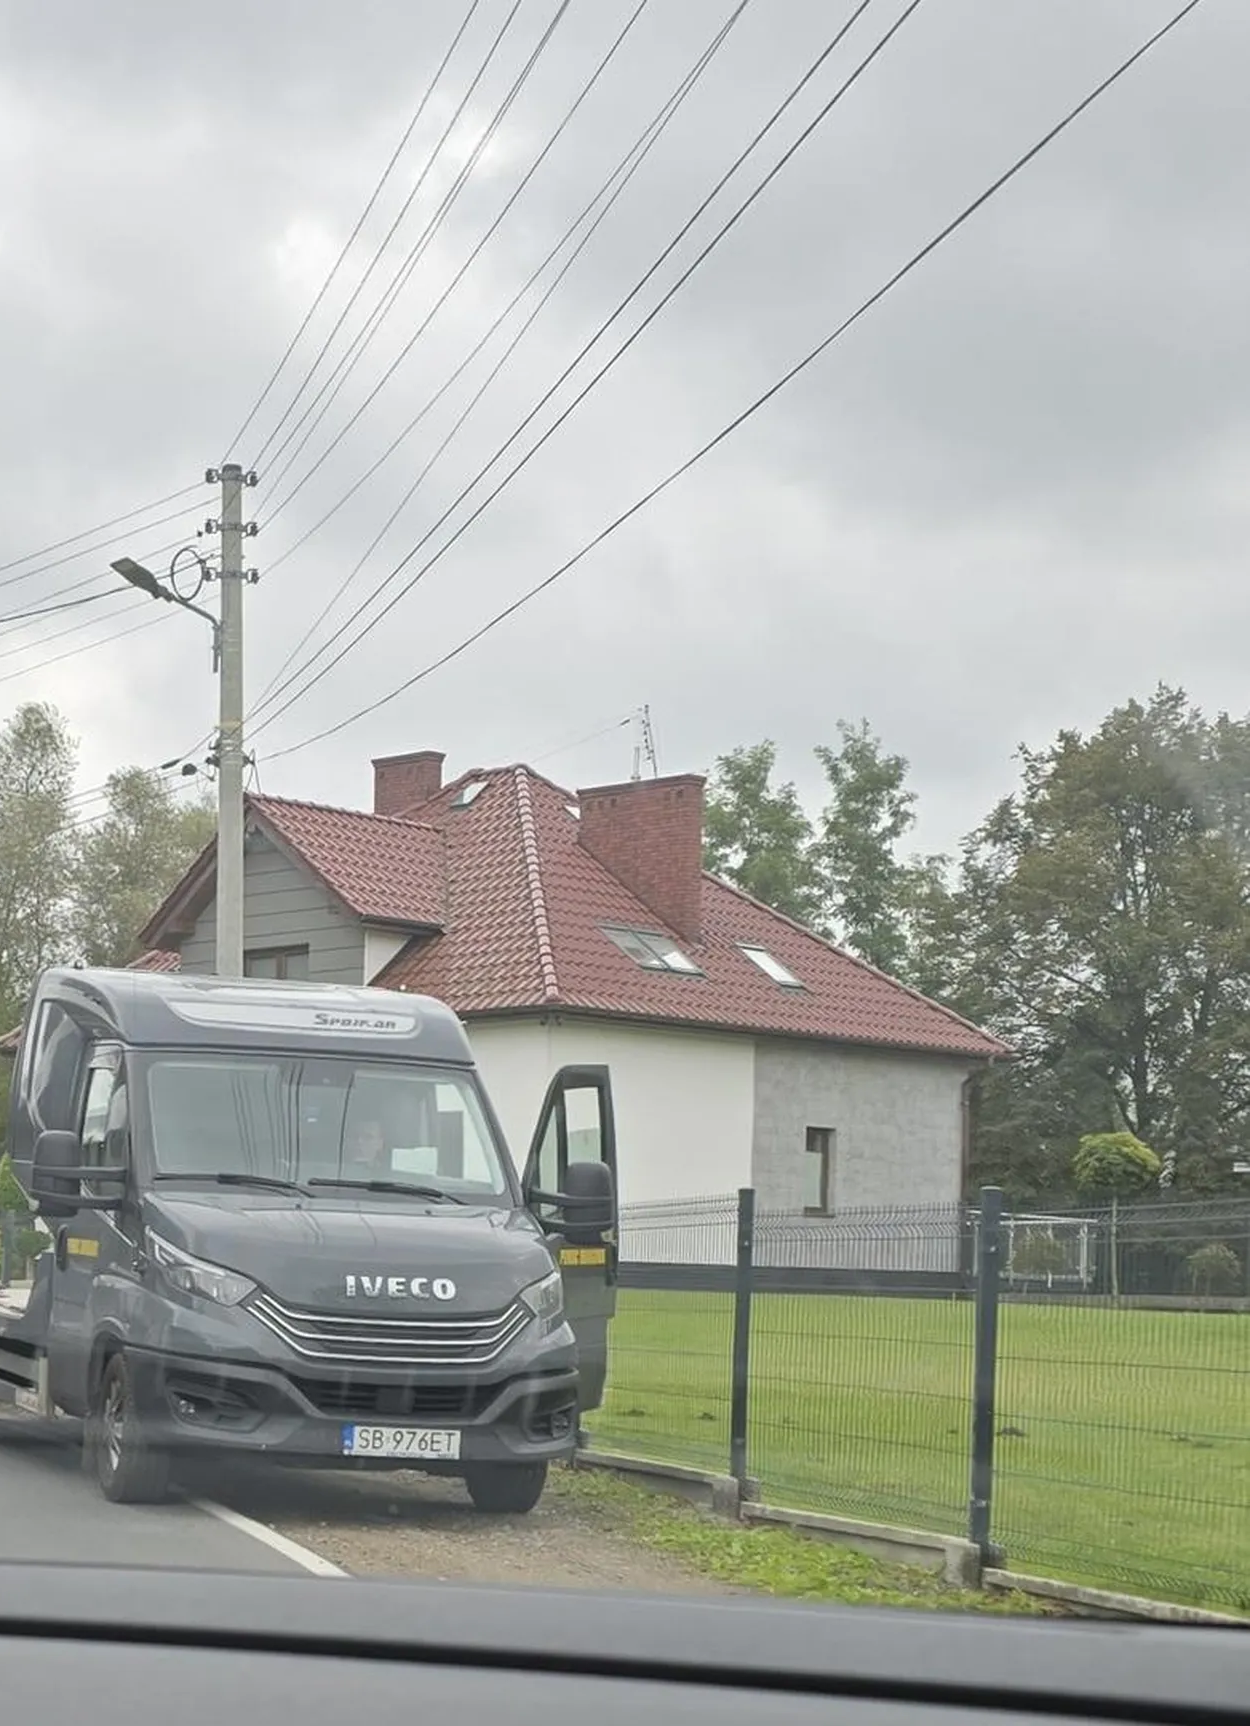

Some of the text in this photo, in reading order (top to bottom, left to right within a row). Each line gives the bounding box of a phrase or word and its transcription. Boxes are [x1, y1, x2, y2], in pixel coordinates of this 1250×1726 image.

[346, 1275, 456, 1300] IVECO
[358, 1428, 457, 1453] SB 976ET
